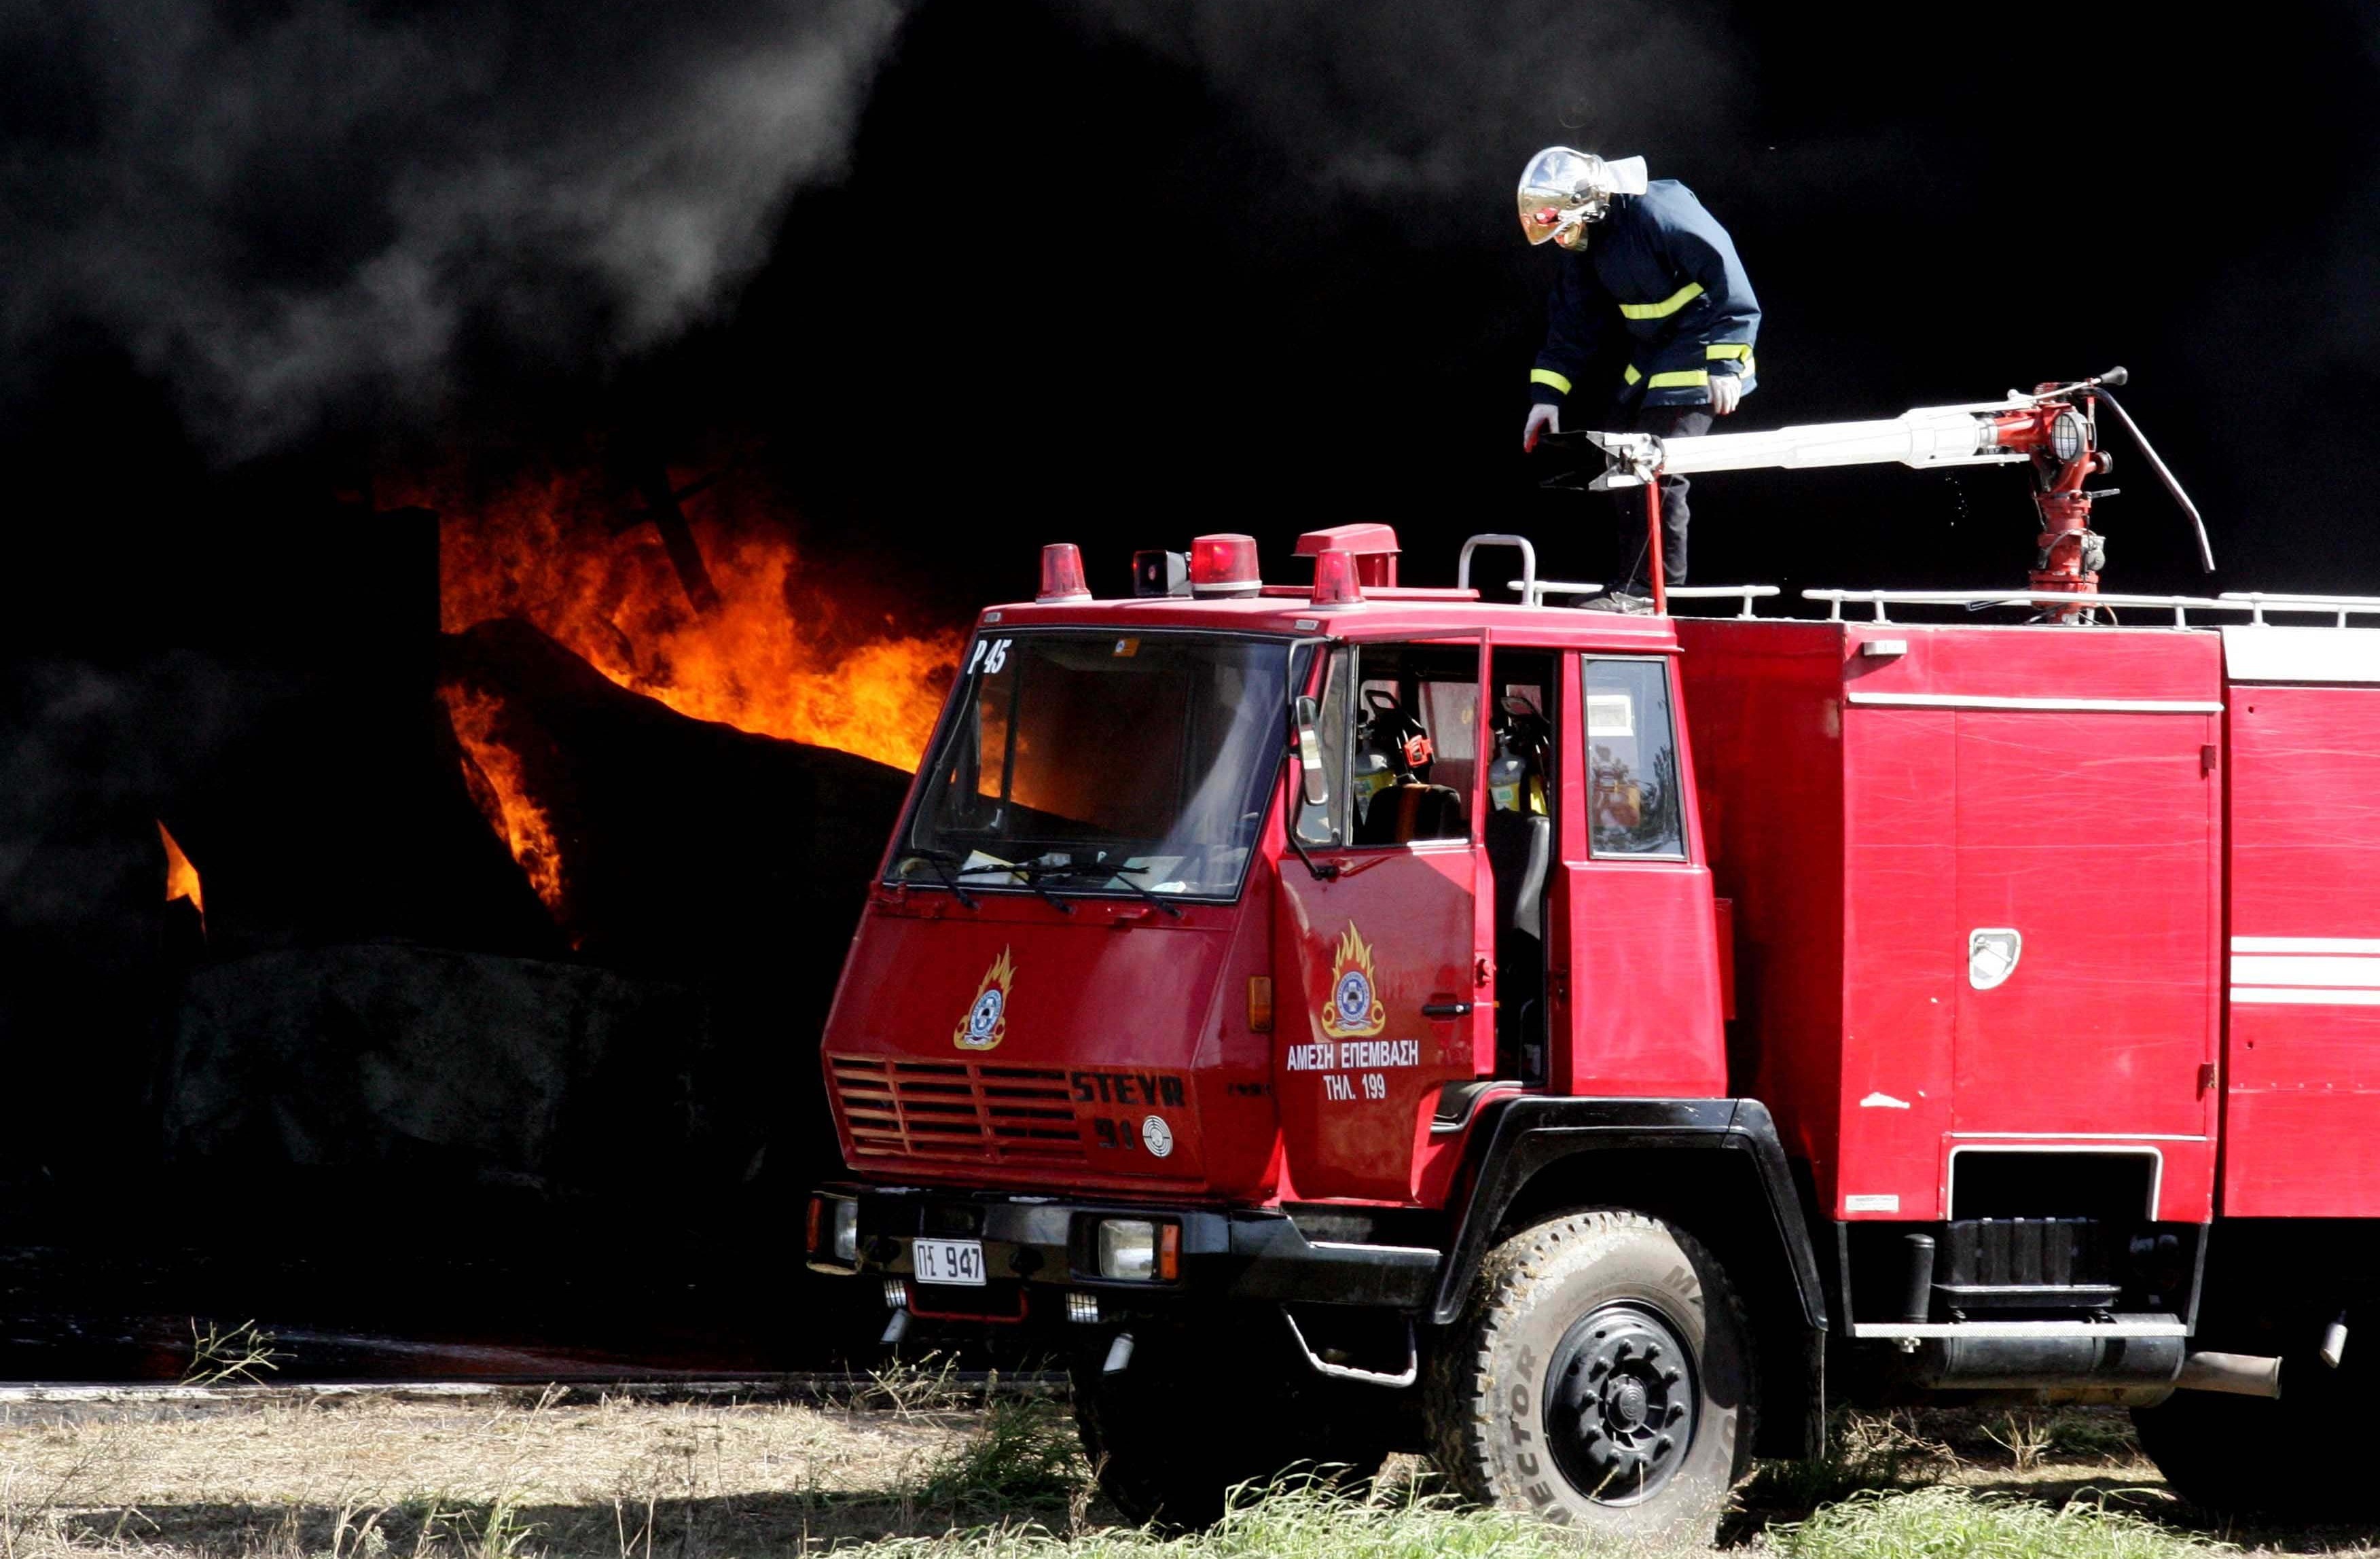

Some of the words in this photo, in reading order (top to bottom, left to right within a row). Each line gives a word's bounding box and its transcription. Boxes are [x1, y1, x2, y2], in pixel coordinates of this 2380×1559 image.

[967, 639, 988, 675] P
[983, 639, 1013, 675] 45
[1287, 1043, 1334, 1071] ΑΜΕΣΗ
[1341, 1040, 1419, 1069] ΕΠΕΜΒΑΣΗ
[1071, 1071, 1185, 1107] STEYR
[1323, 1075, 1356, 1100] ΤΗΛ.
[1362, 1073, 1386, 1099] 199
[1094, 1117, 1134, 1149] 91
[945, 1246, 980, 1278] 947
